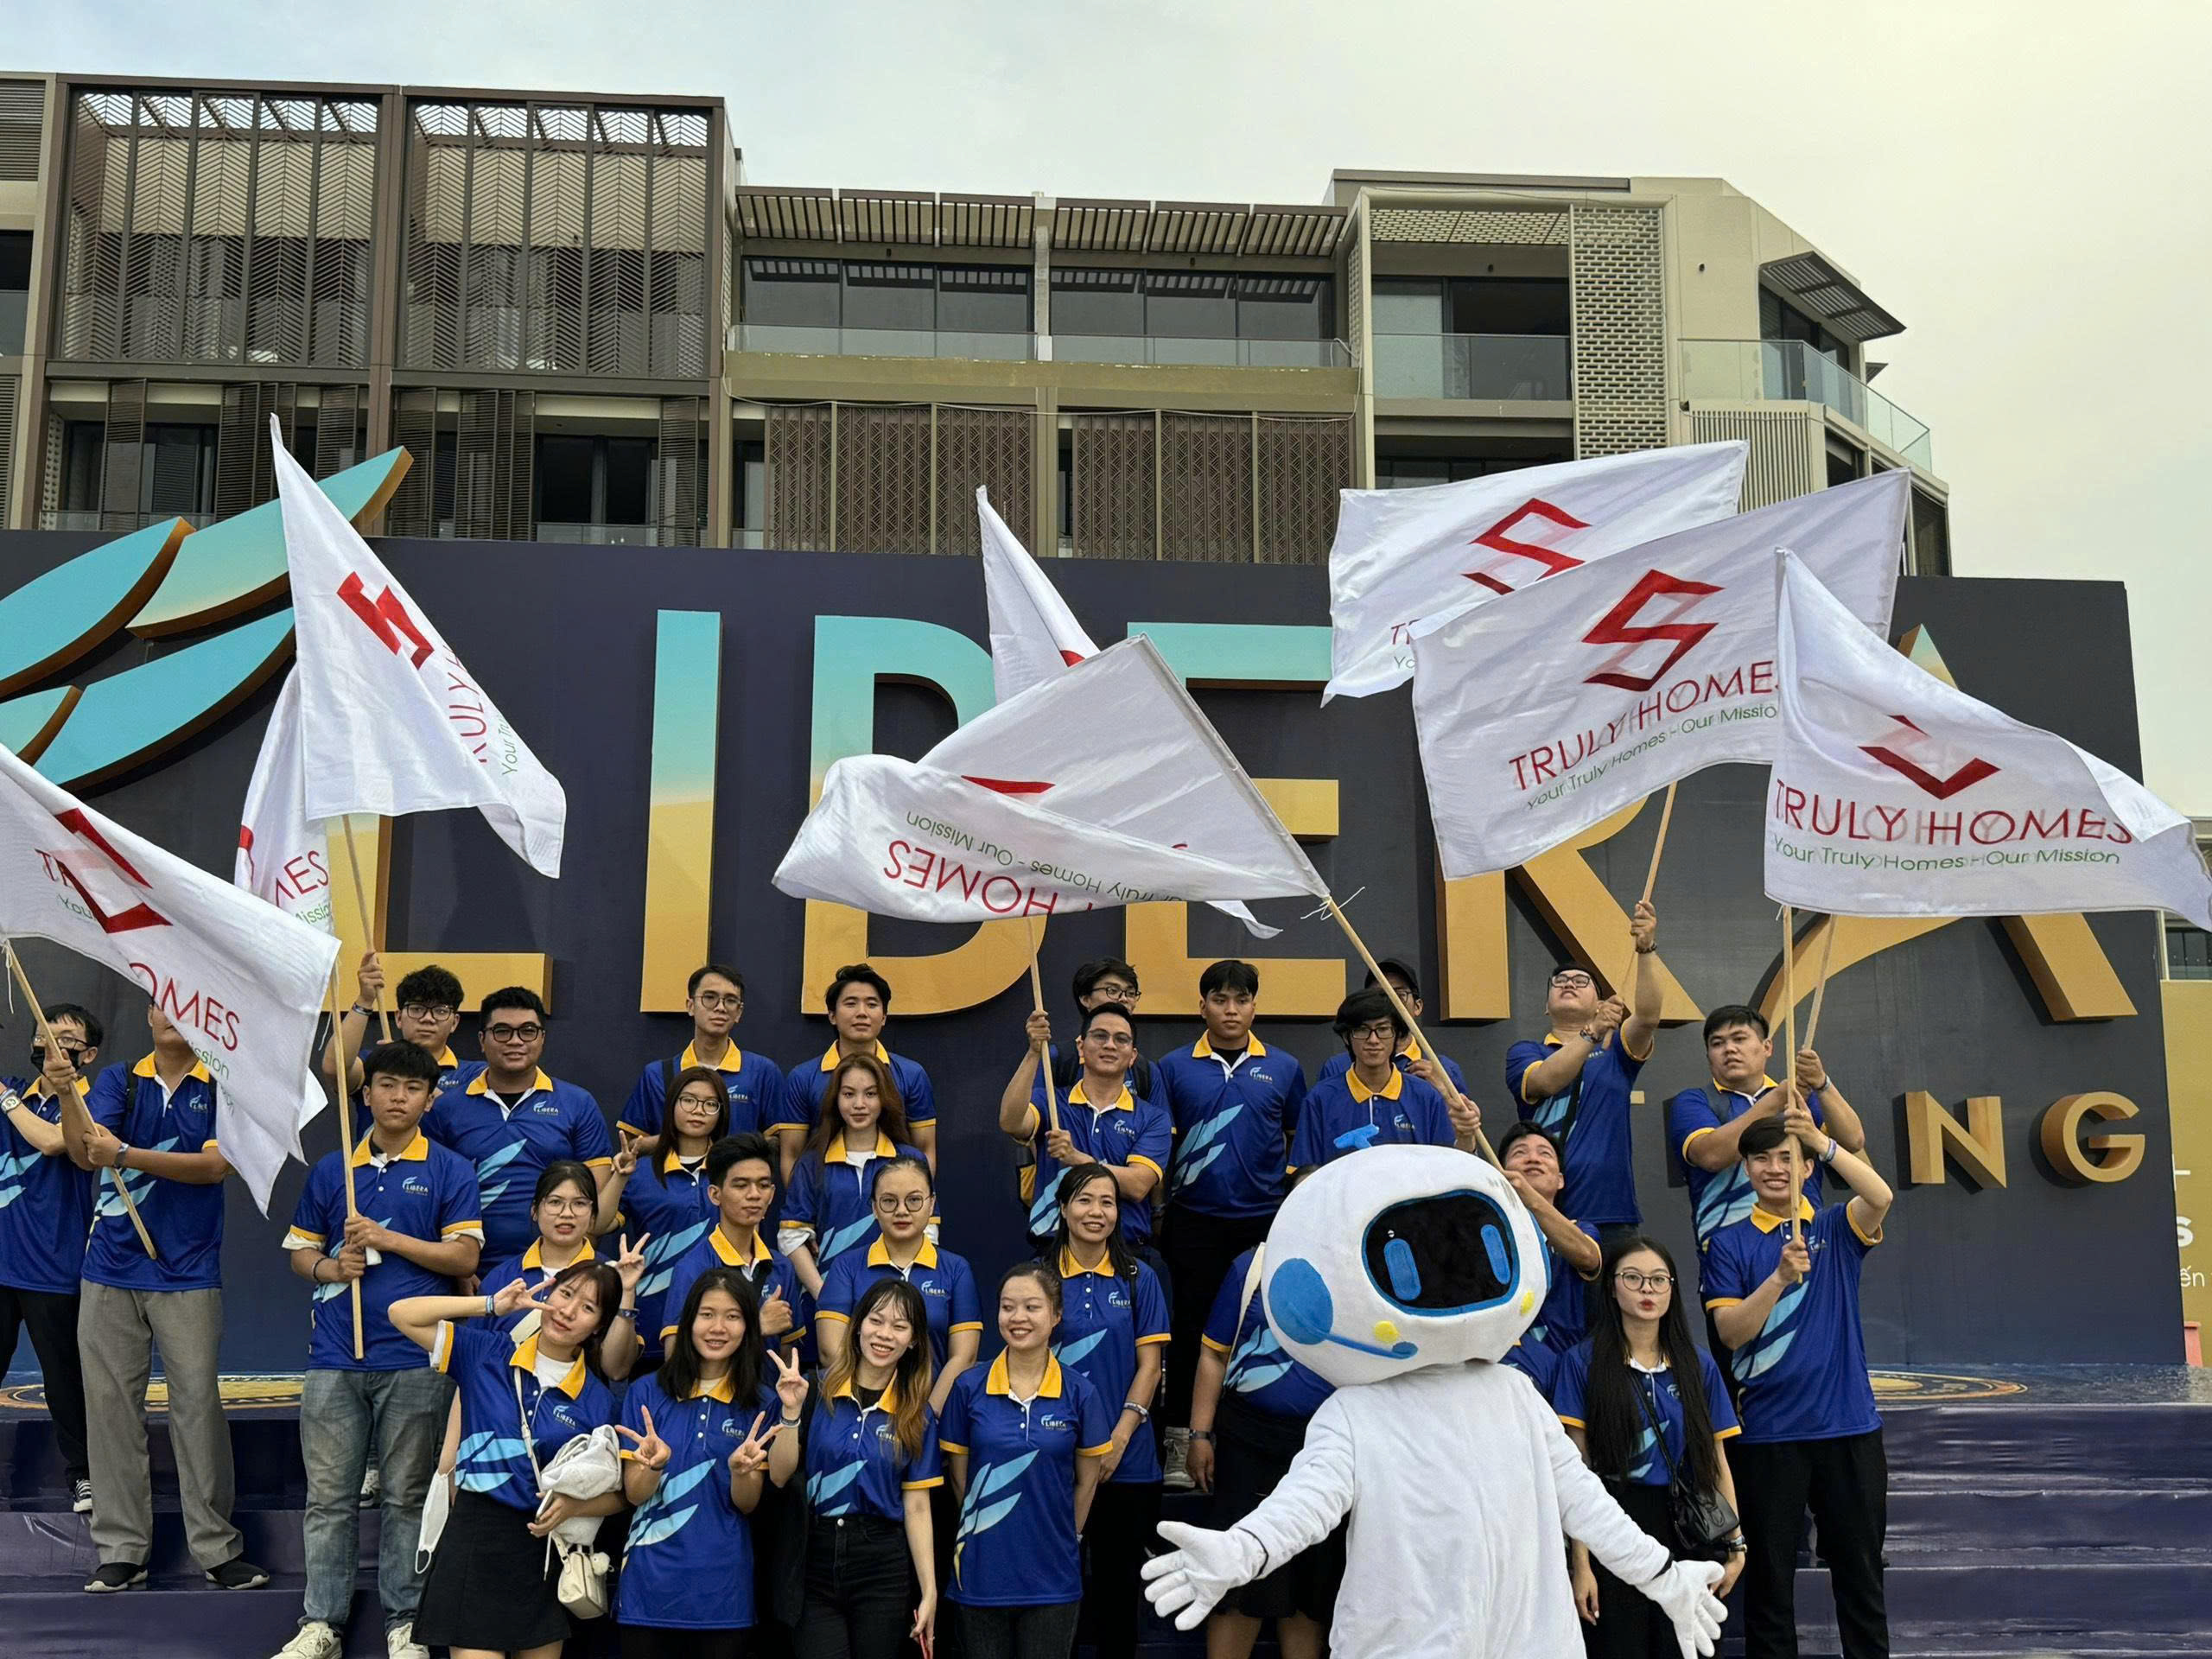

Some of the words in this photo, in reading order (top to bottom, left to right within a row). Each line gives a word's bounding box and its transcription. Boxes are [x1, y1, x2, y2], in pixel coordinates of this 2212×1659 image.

[1394, 656, 1417, 669] Yo
[500, 739, 518, 776] Your
[1509, 712, 1626, 791] TRULY
[1638, 660, 1779, 730] HOME
[1527, 784, 1581, 810] Your
[1568, 762, 1608, 791] Truly
[1611, 732, 1666, 768] Homes
[1681, 715, 1714, 734] Our
[1720, 702, 1777, 723] Missio
[1777, 779, 1907, 842] TRULY
[1928, 808, 2133, 846] HOMES
[276, 850, 329, 908] MES
[883, 840, 1058, 917] HOMES
[906, 810, 975, 851] Mission
[977, 841, 1014, 866] Our
[1030, 860, 1102, 894] Homes
[1774, 834, 1815, 863] Your
[1821, 847, 1875, 869] Truly
[1884, 855, 1965, 871] Homes
[1986, 849, 2027, 865] Our
[2036, 848, 2120, 864] Mission
[57, 893, 97, 921] You
[129, 962, 240, 1052] MES
